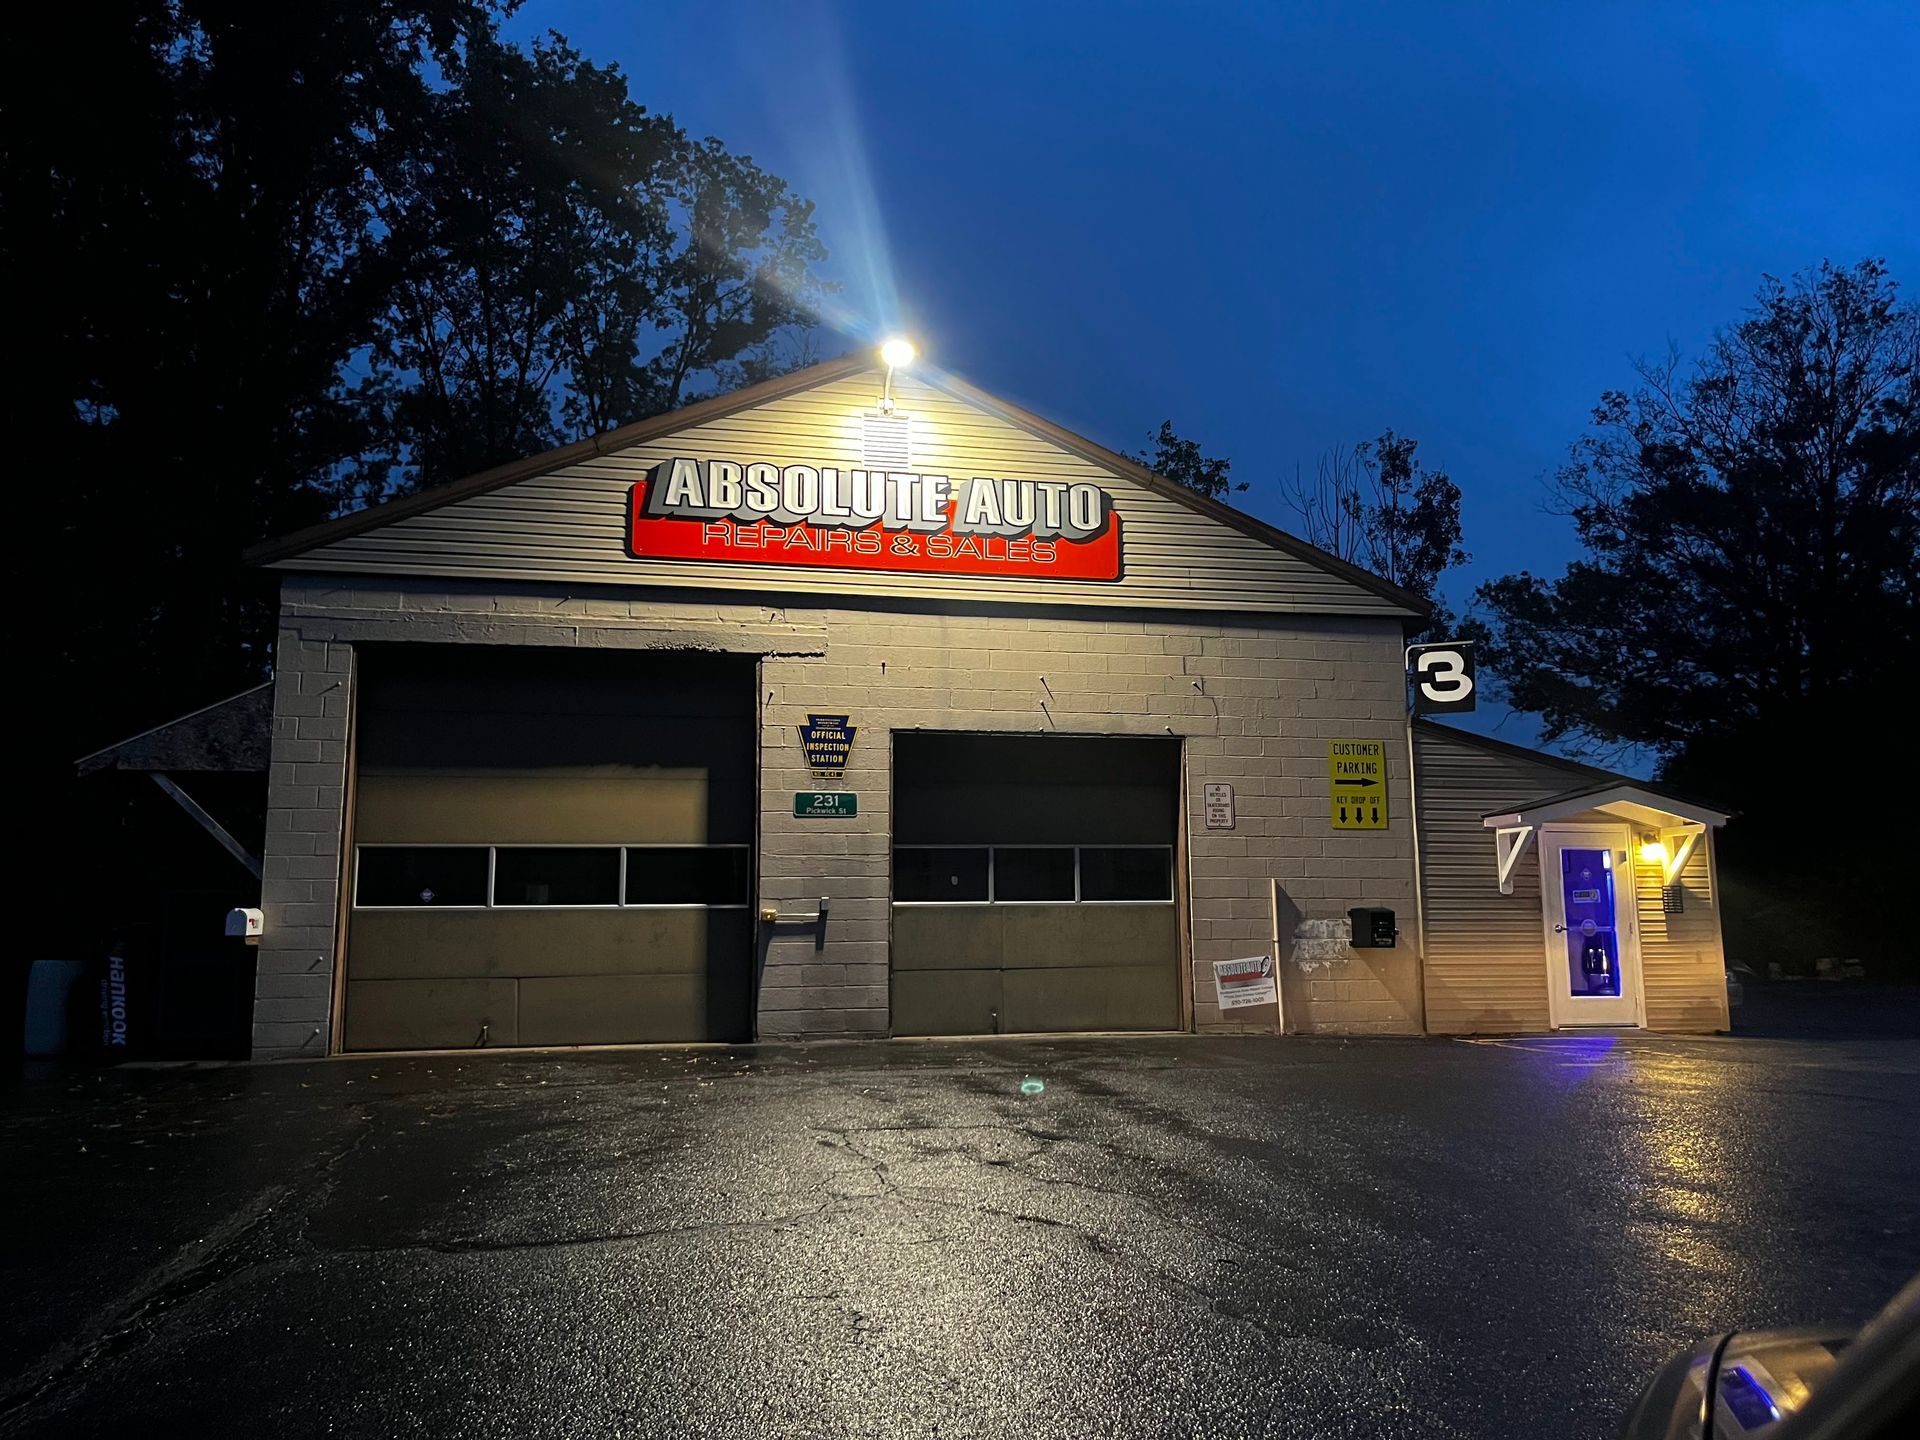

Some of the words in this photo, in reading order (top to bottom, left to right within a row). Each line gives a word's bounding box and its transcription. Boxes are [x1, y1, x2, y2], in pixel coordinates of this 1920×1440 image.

[662, 457, 951, 524] ABSOLUTE
[964, 475, 1103, 532] AUTO
[702, 521, 882, 555] REPAIRS
[889, 534, 920, 557] &
[926, 534, 1057, 563] SALES
[1418, 650, 1473, 702] 3
[811, 731, 846, 740] OFFICIAL
[806, 742, 850, 751] INSPECTION
[1333, 743, 1379, 756] CUSTOMER
[811, 754, 843, 763] STATION
[1336, 762, 1377, 775] PARKING
[814, 794, 839, 807] 231
[1336, 795, 1347, 804] KEY
[838, 807, 847, 815] St
